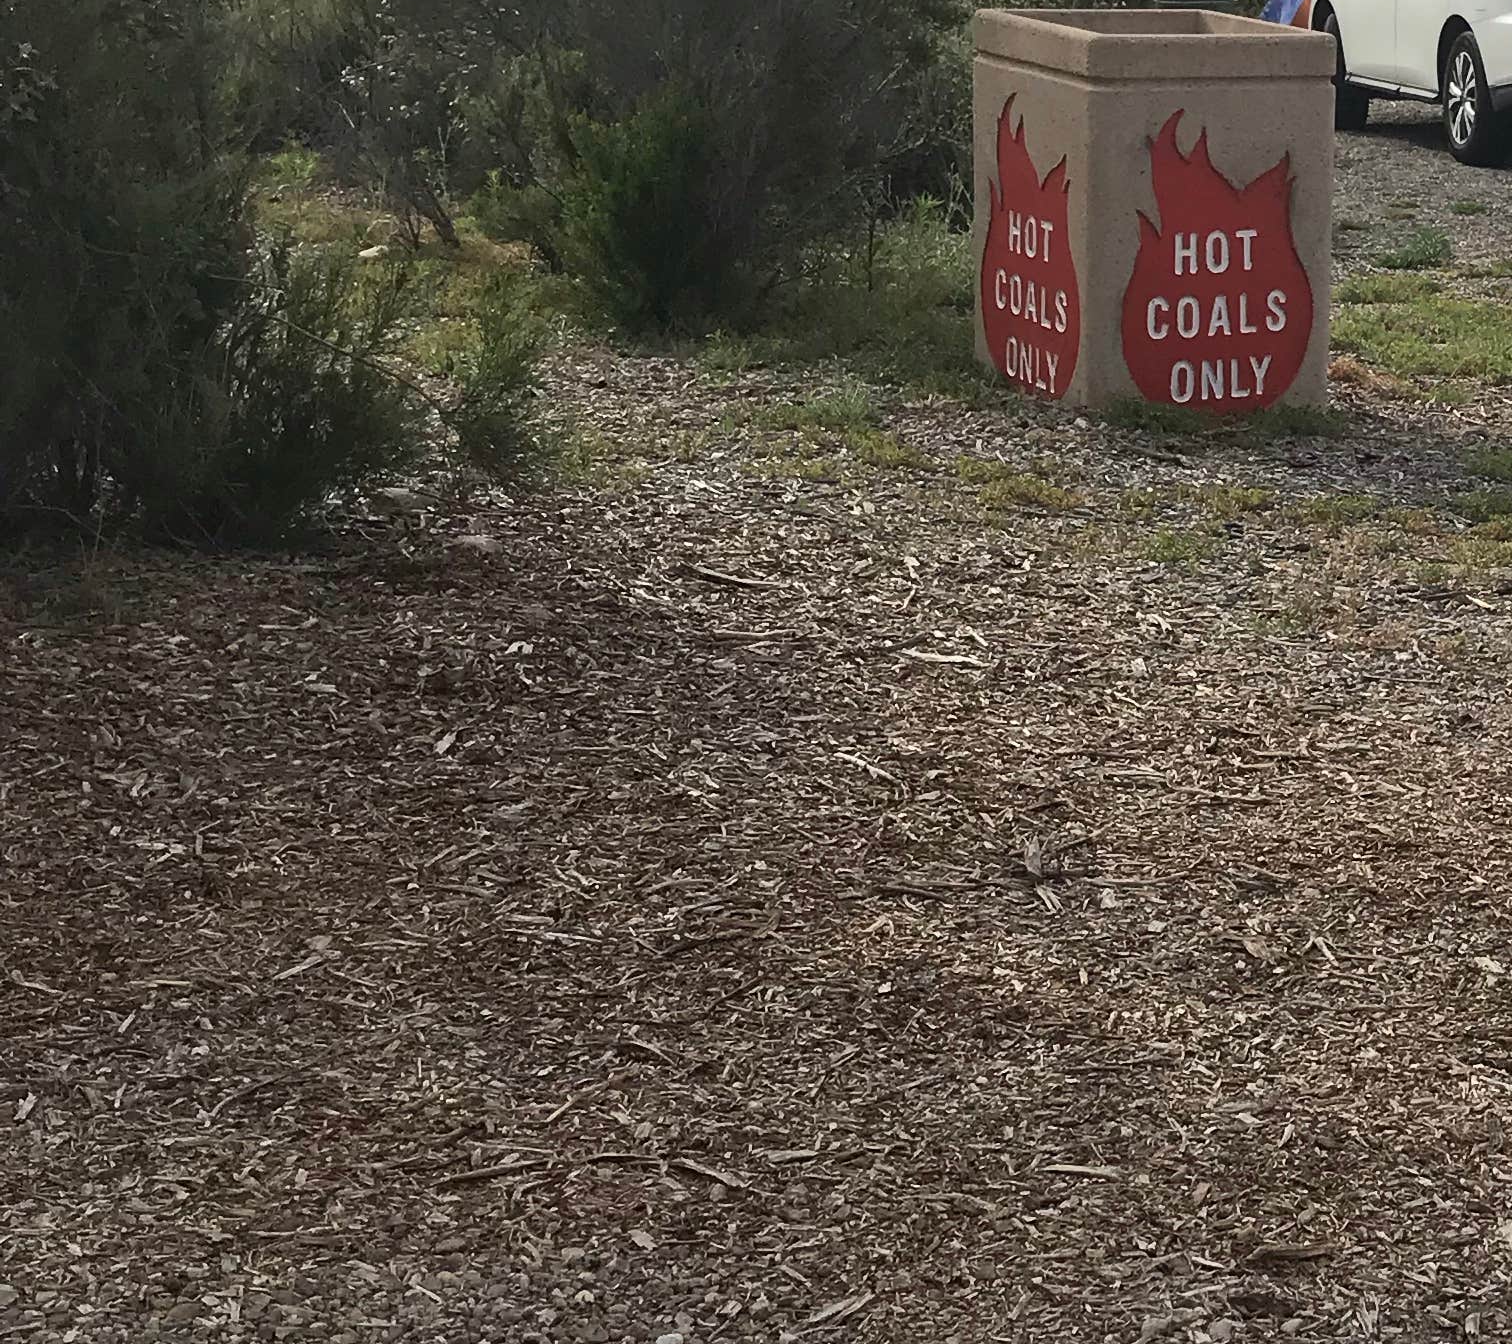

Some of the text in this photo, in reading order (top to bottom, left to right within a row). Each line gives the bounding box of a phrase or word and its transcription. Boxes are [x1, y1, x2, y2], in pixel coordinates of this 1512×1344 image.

[1008, 209, 1054, 262] HOT
[1174, 229, 1258, 276] HOT
[995, 268, 1068, 333] COALS
[1147, 289, 1288, 340] COALS
[1006, 336, 1060, 394] ONLY
[1170, 355, 1272, 404] ONLY
